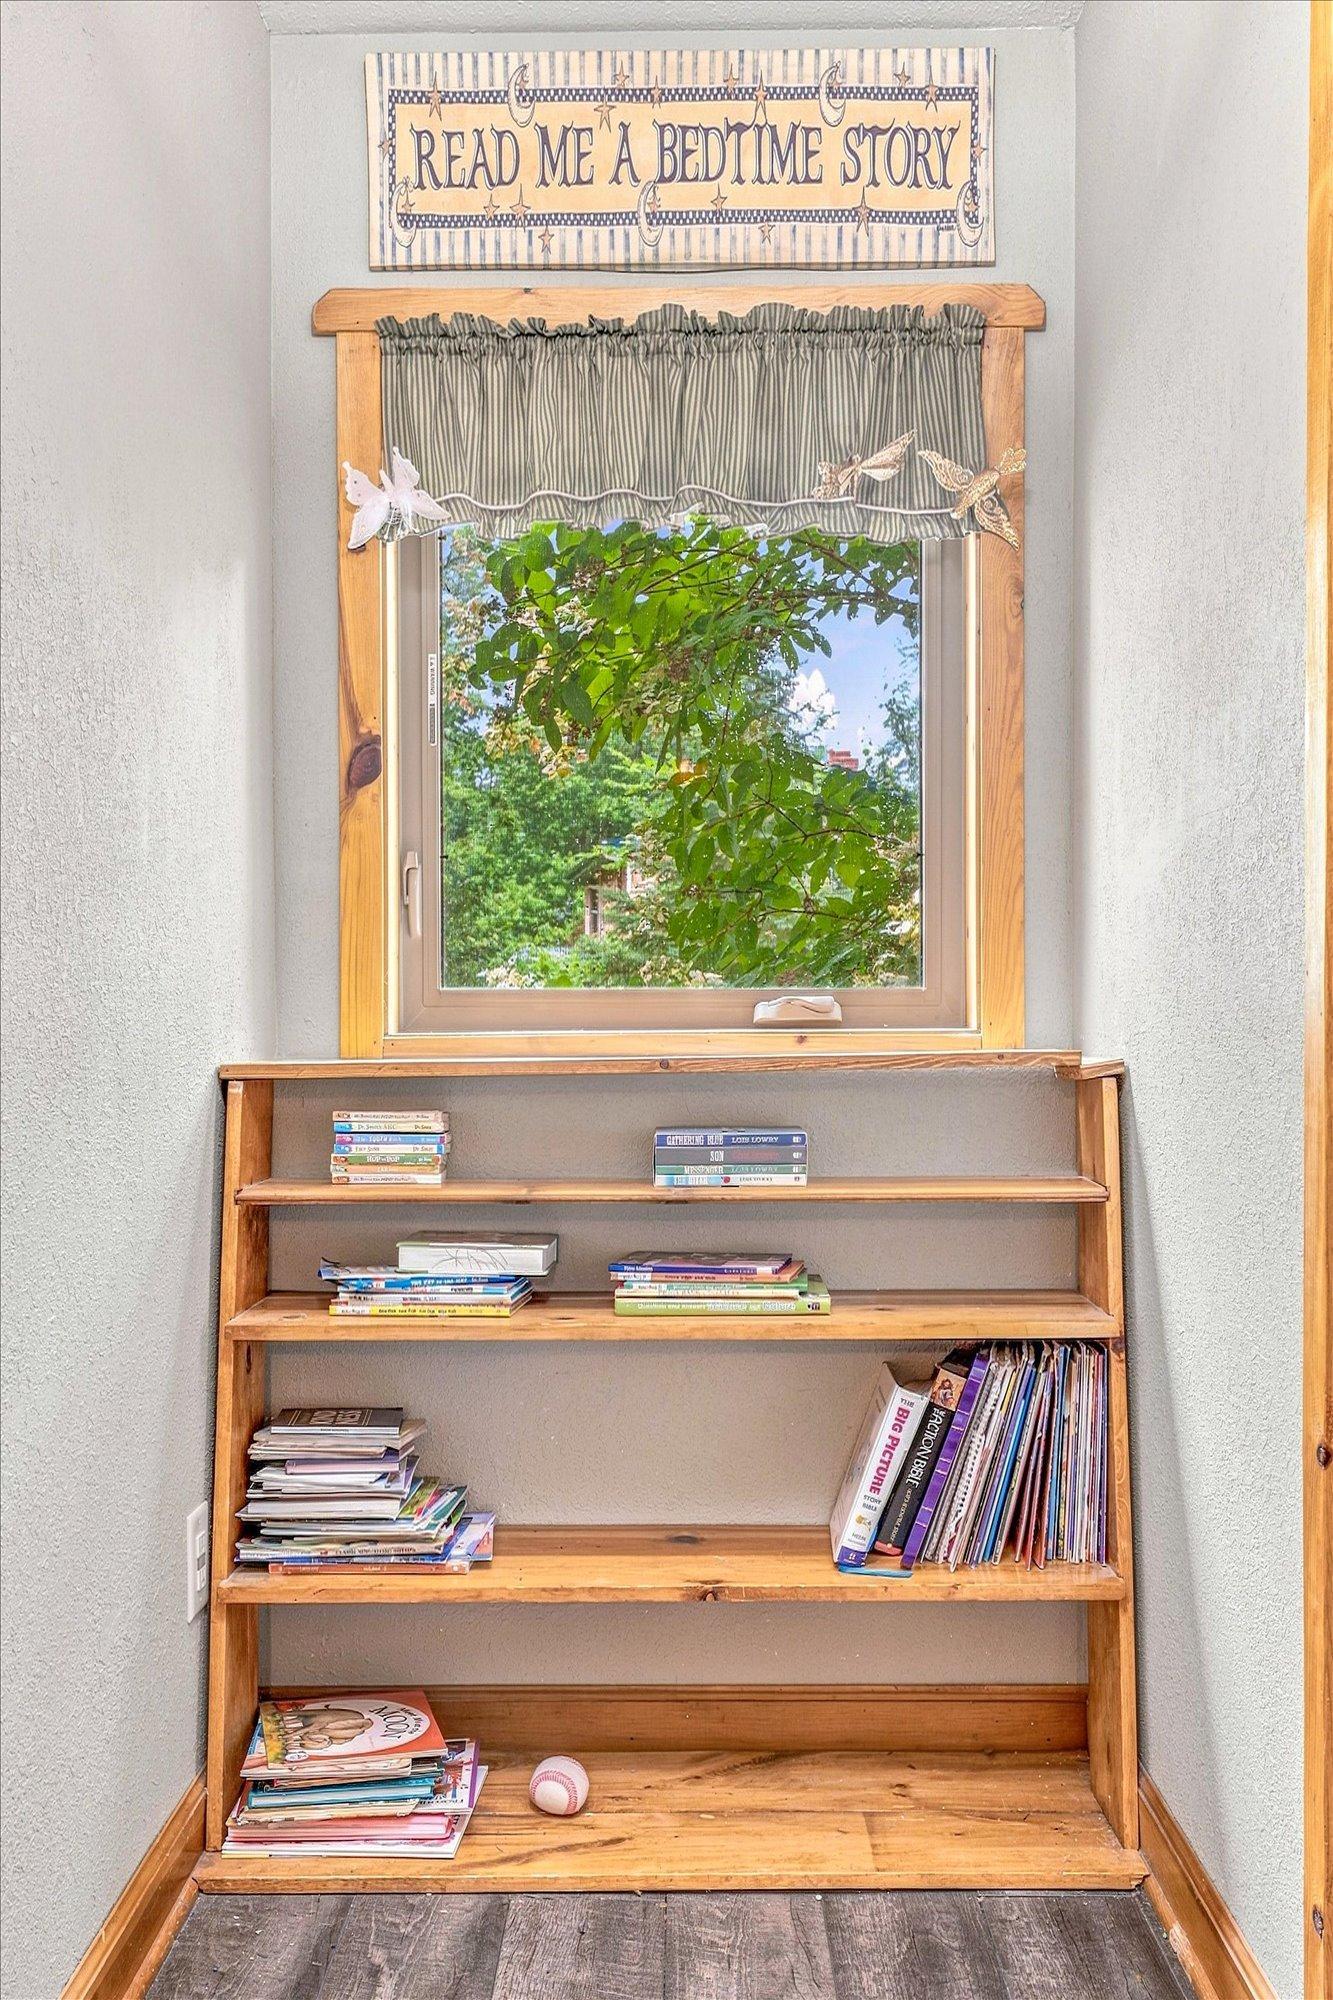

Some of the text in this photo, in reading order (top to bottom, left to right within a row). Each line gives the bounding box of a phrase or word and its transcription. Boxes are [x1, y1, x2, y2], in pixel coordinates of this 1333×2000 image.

[410, 117, 961, 191] READ ME A BEDTIME STORY
[666, 1135, 704, 1146] GATHERING
[731, 1136, 779, 1144] LOIS LOWRY
[710, 1150, 725, 1162] SON
[891, 1406, 911, 1434] BIG
[869, 1433, 901, 1496] PICTURE
[905, 1413, 943, 1489] ACTION BIBLE
